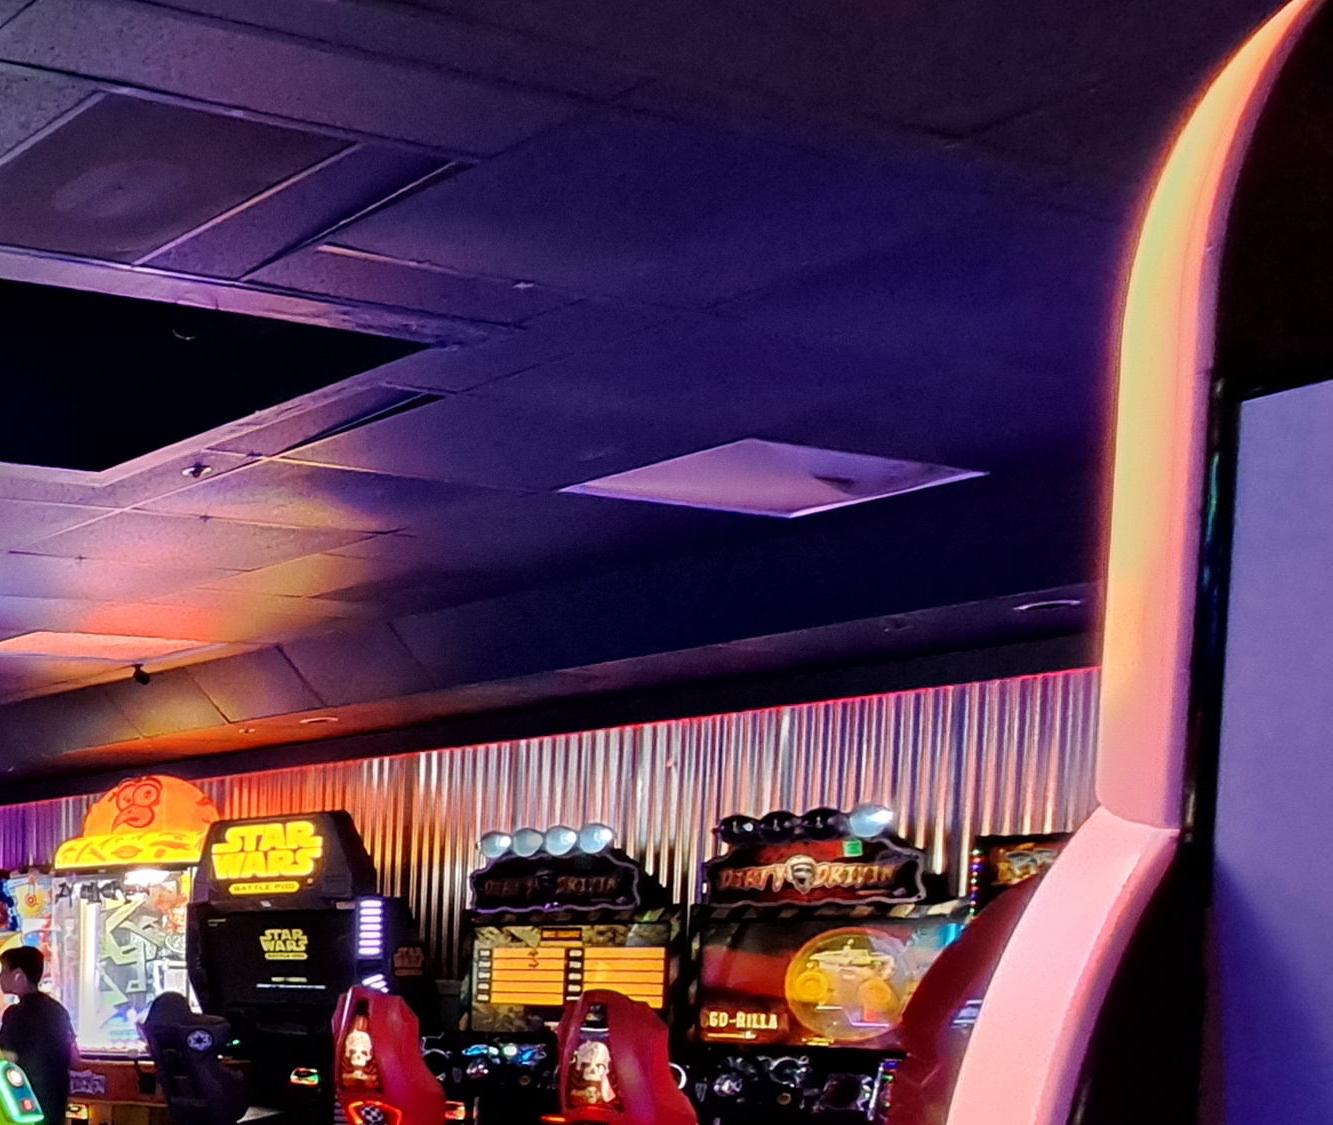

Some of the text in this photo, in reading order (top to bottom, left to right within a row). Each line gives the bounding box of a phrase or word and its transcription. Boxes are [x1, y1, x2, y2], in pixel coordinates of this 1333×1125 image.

[212, 820, 323, 854] STAR
[212, 847, 323, 880] WARS
[259, 928, 308, 941] STAR
[259, 938, 309, 952] WARS
